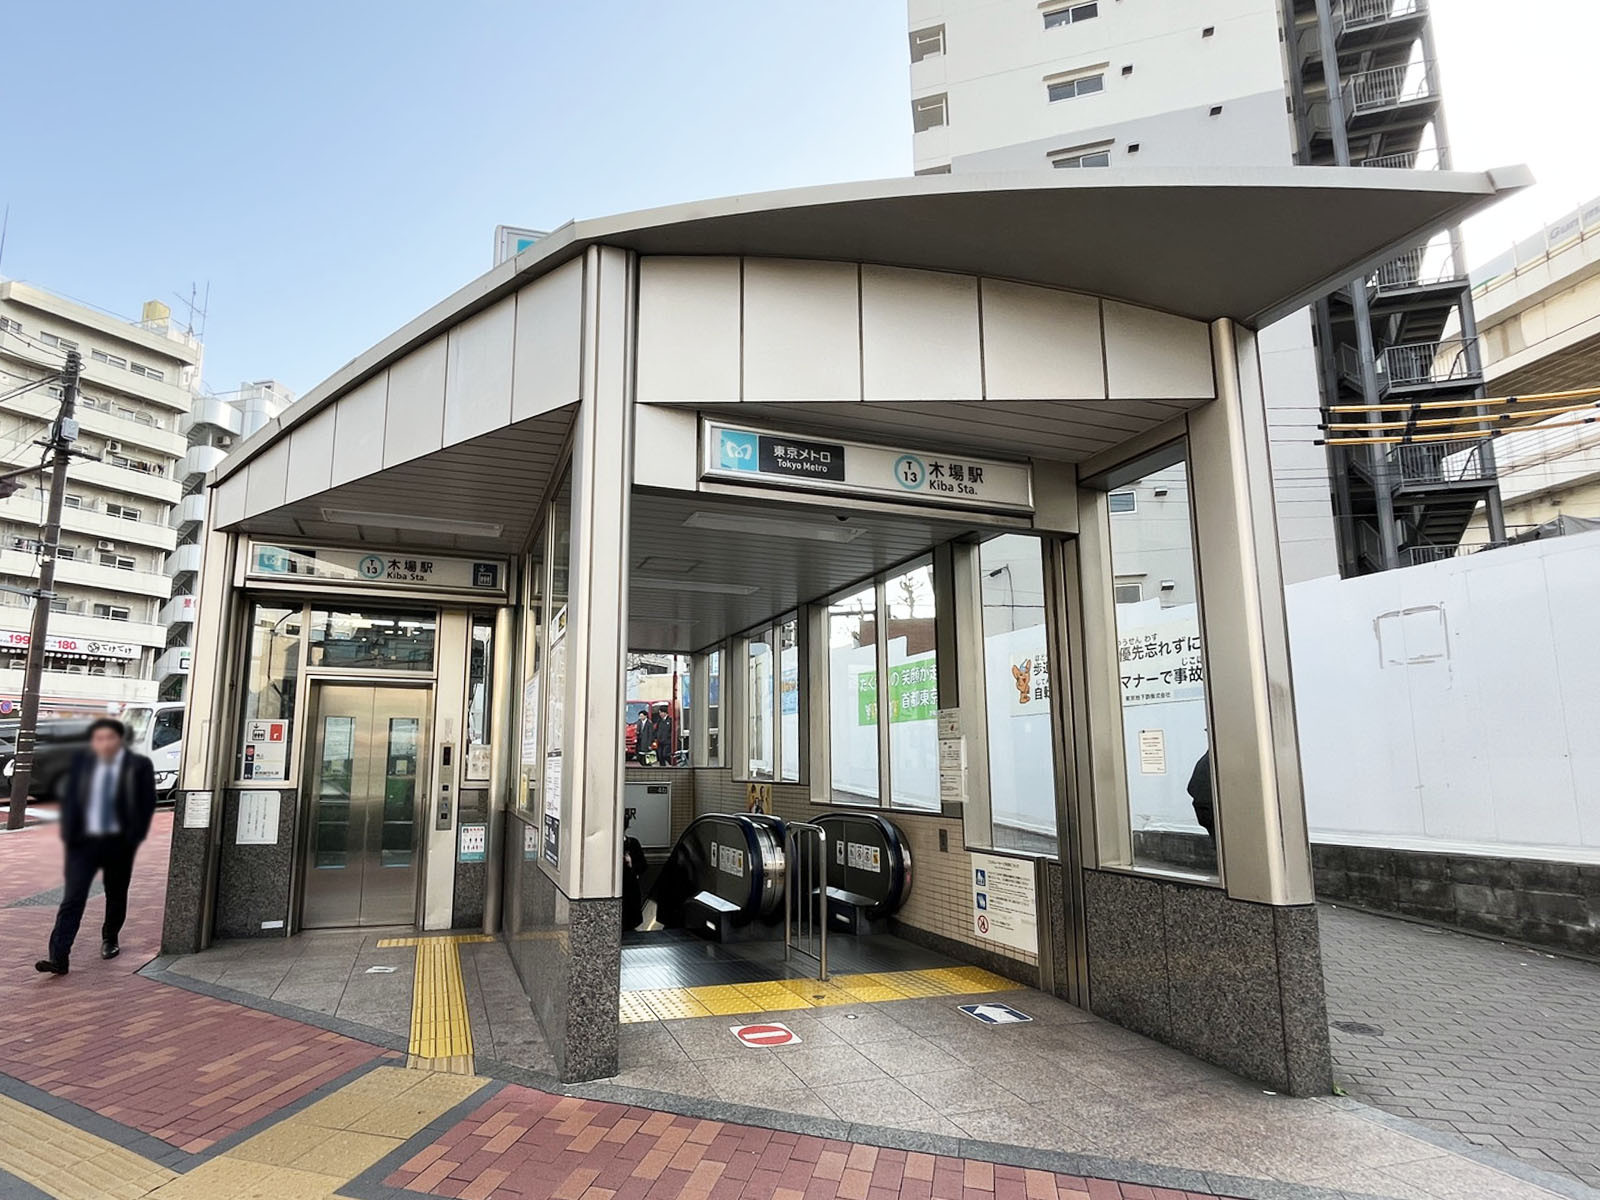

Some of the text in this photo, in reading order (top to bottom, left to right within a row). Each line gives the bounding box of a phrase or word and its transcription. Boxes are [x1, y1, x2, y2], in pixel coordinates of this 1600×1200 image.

[773, 445, 831, 463] 東京メトロ
[777, 458, 828, 473] Tokyo Metro
[906, 461, 913, 470] T
[928, 461, 984, 484] 木場駅
[904, 471, 918, 483] 13
[929, 479, 978, 496] Kiba Sta.
[366, 566, 379, 575] 13
[387, 559, 433, 574] 木場駅
[387, 571, 428, 582] Kiba Sta.
